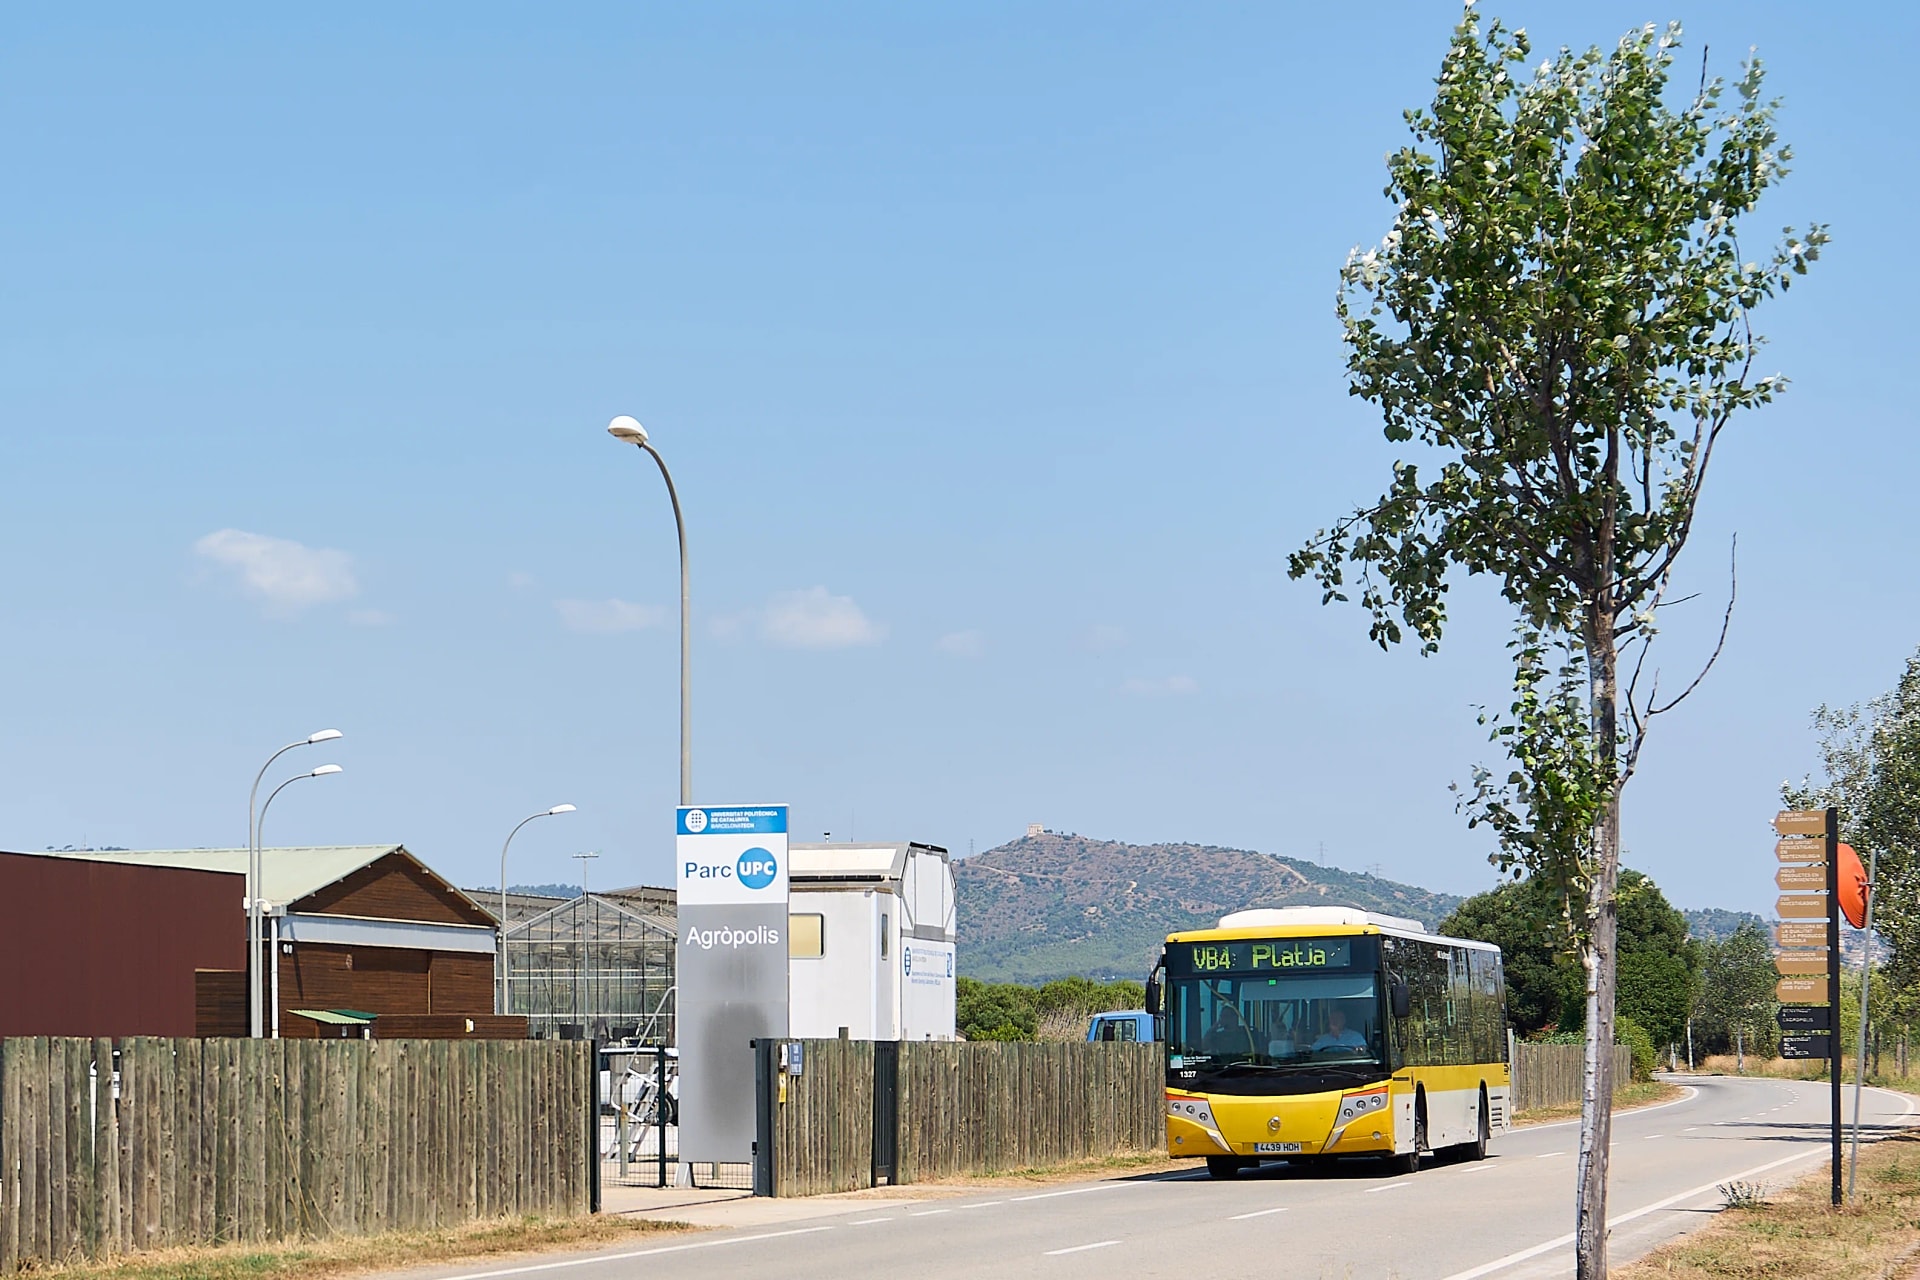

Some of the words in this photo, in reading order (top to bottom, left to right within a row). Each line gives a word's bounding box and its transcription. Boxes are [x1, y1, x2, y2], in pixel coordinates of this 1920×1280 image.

[685, 862, 732, 879] Parc
[739, 860, 775, 877] UPC
[685, 925, 779, 950] Agròpolis
[1251, 943, 1326, 969] Platja
[1180, 1070, 1197, 1078] 1327
[1260, 1143, 1281, 1152] 4439
[1283, 1142, 1300, 1152] HDH
